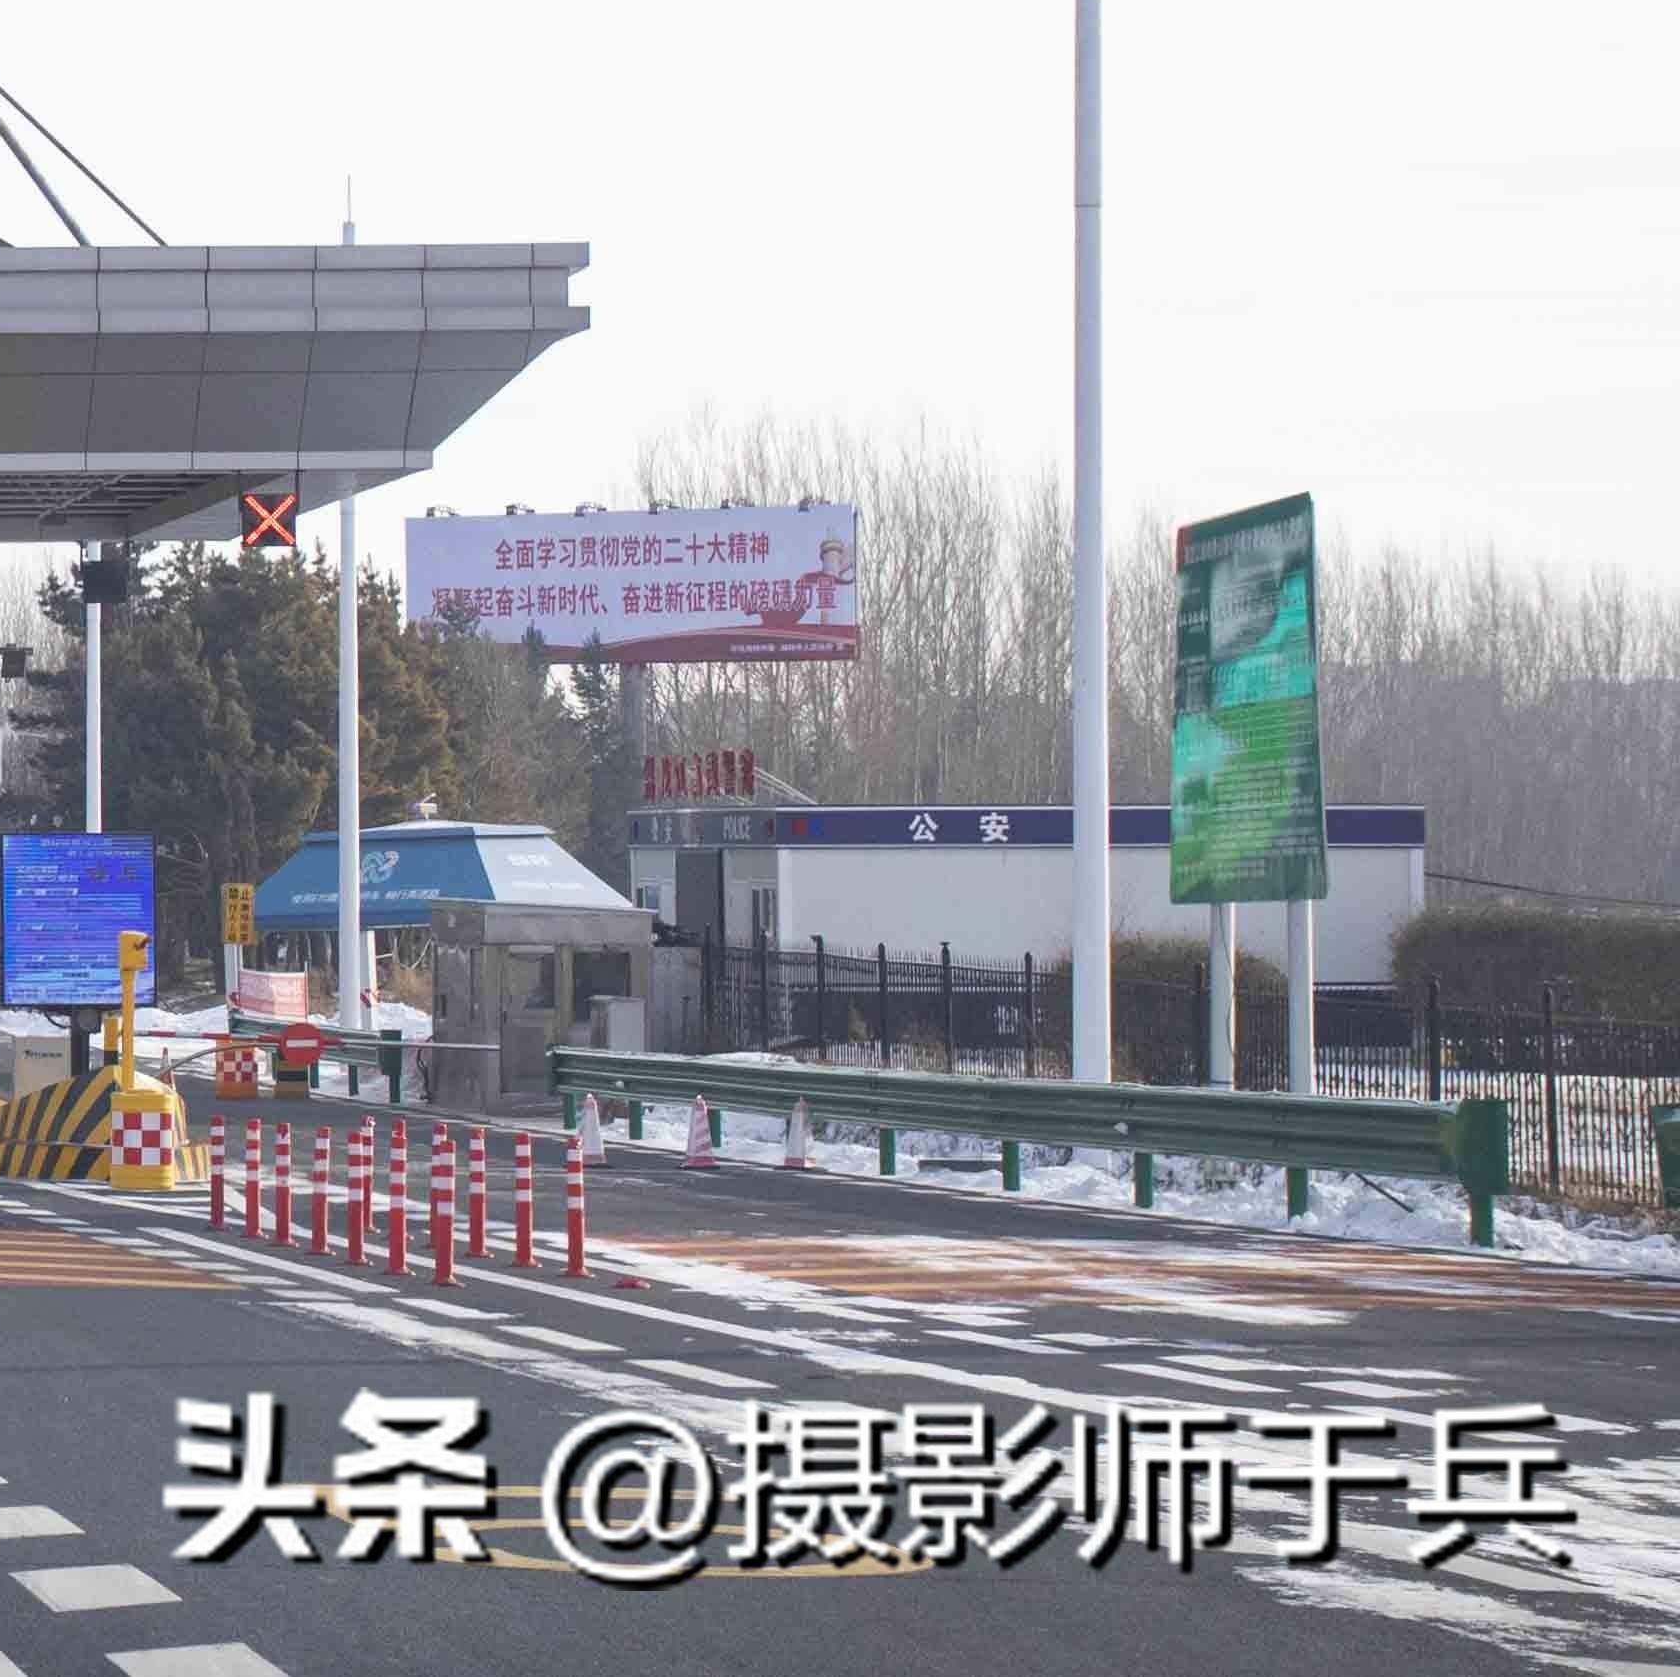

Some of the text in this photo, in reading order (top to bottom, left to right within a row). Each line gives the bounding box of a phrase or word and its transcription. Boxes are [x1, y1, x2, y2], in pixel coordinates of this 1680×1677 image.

[495, 531, 770, 571] 全面学习贯彻党的二十大精神
[908, 812, 1010, 843] 公安
